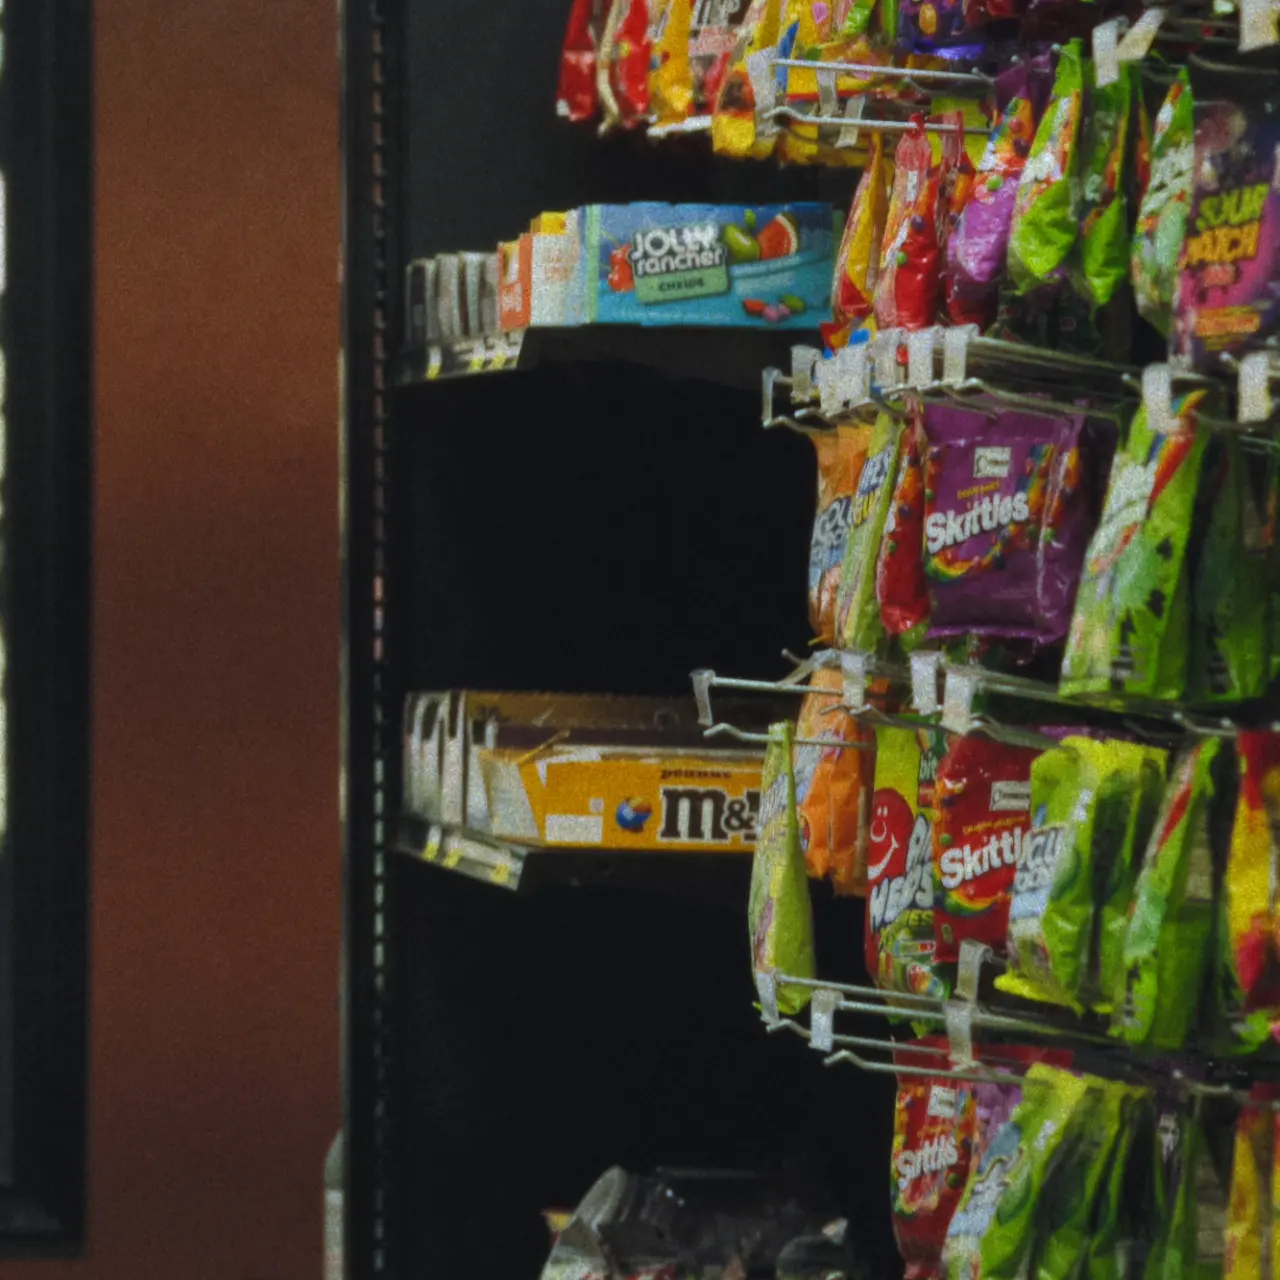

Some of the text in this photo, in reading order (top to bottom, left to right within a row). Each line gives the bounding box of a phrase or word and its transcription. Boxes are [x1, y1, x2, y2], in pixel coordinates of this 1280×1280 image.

[631, 221, 721, 260] JOLLY
[636, 246, 724, 277] rancher
[925, 492, 1030, 554] Skittles
[939, 825, 1024, 890] Skittl
